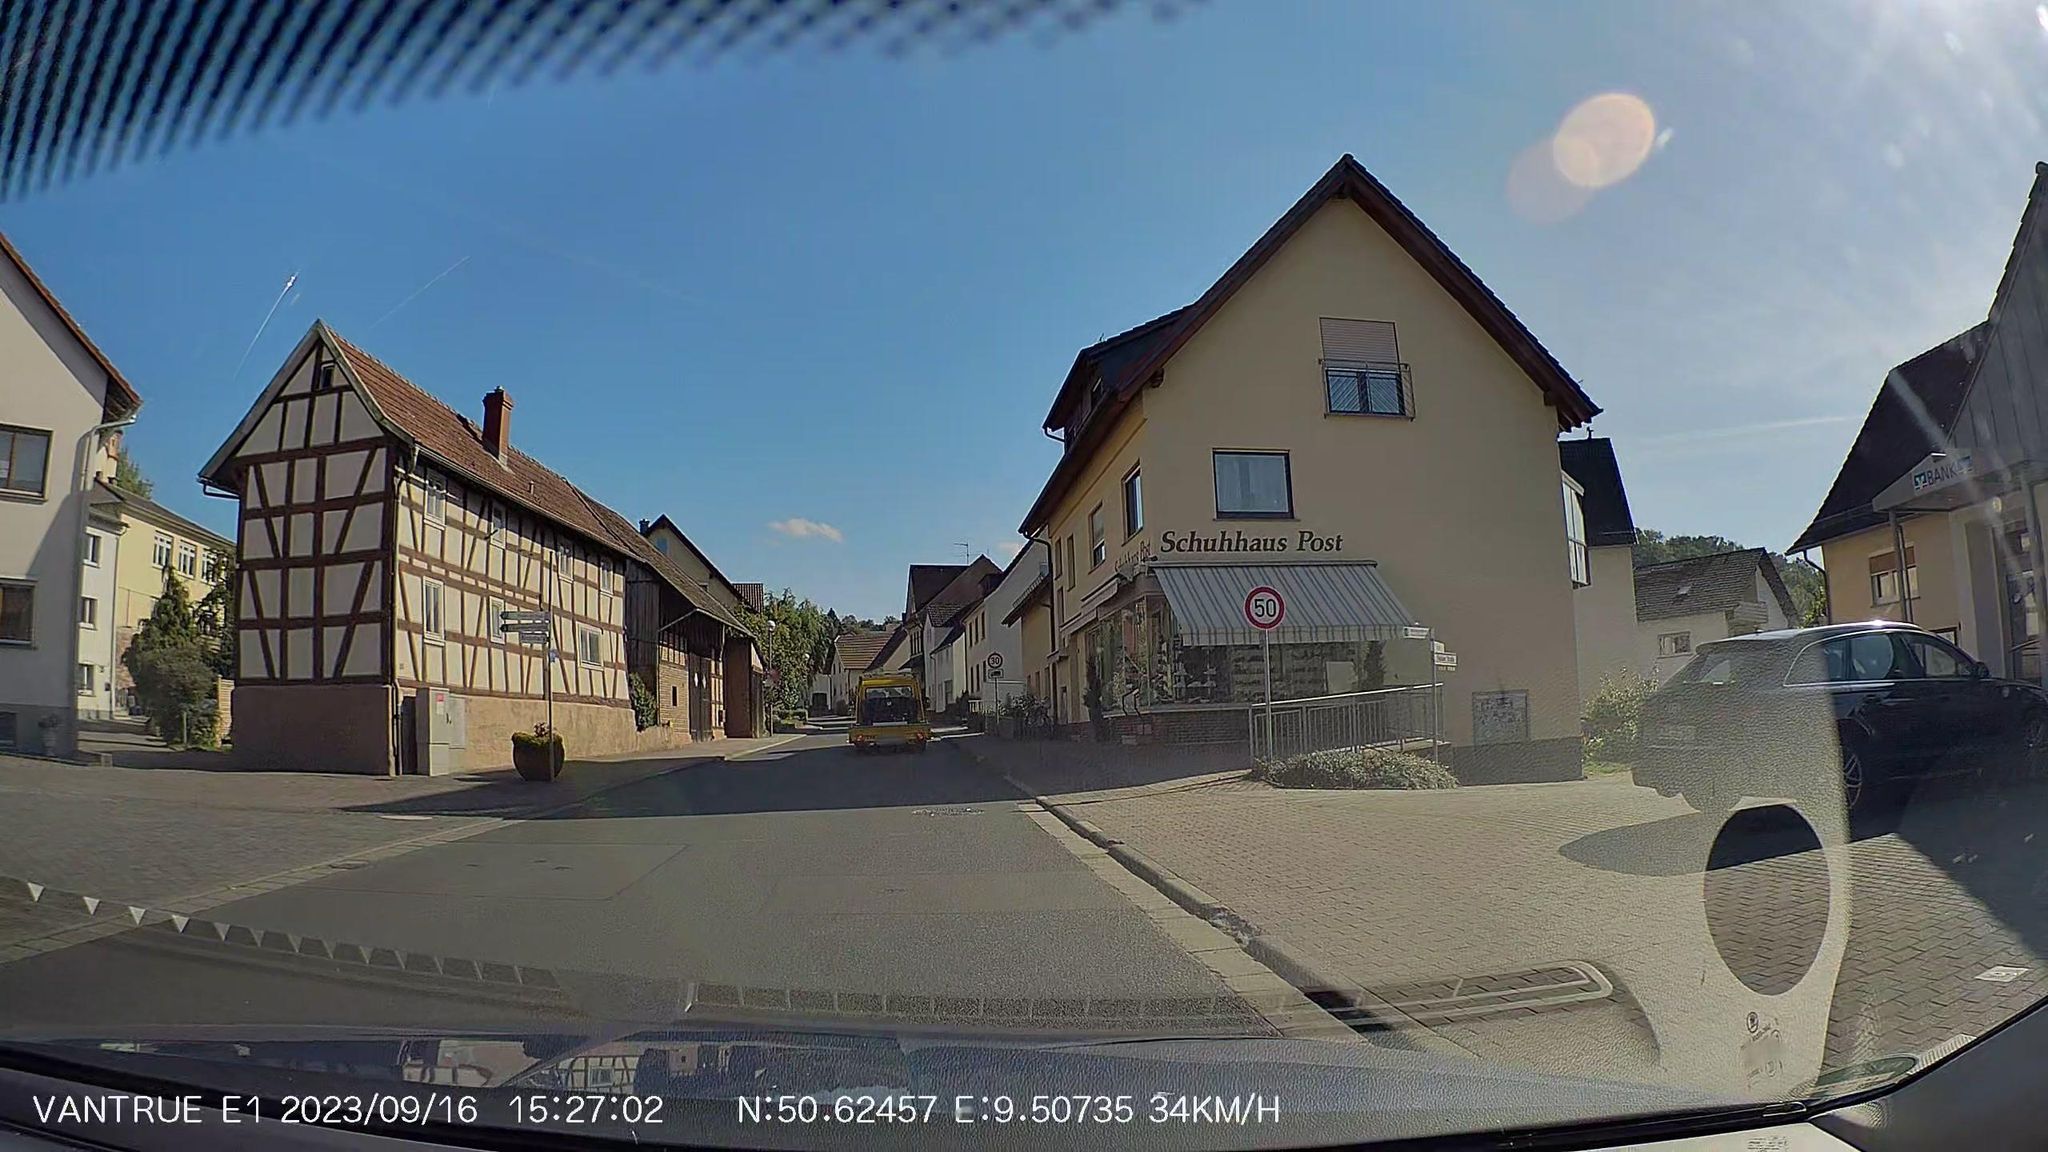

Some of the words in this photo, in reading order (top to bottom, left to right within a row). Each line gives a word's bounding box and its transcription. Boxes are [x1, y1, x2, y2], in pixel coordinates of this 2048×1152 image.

[1926, 463, 1957, 486] BANK
[1160, 530, 1288, 553] Schuhhaus
[1297, 530, 1344, 552] Post
[1254, 598, 1276, 618] 50
[990, 656, 1000, 665] 30
